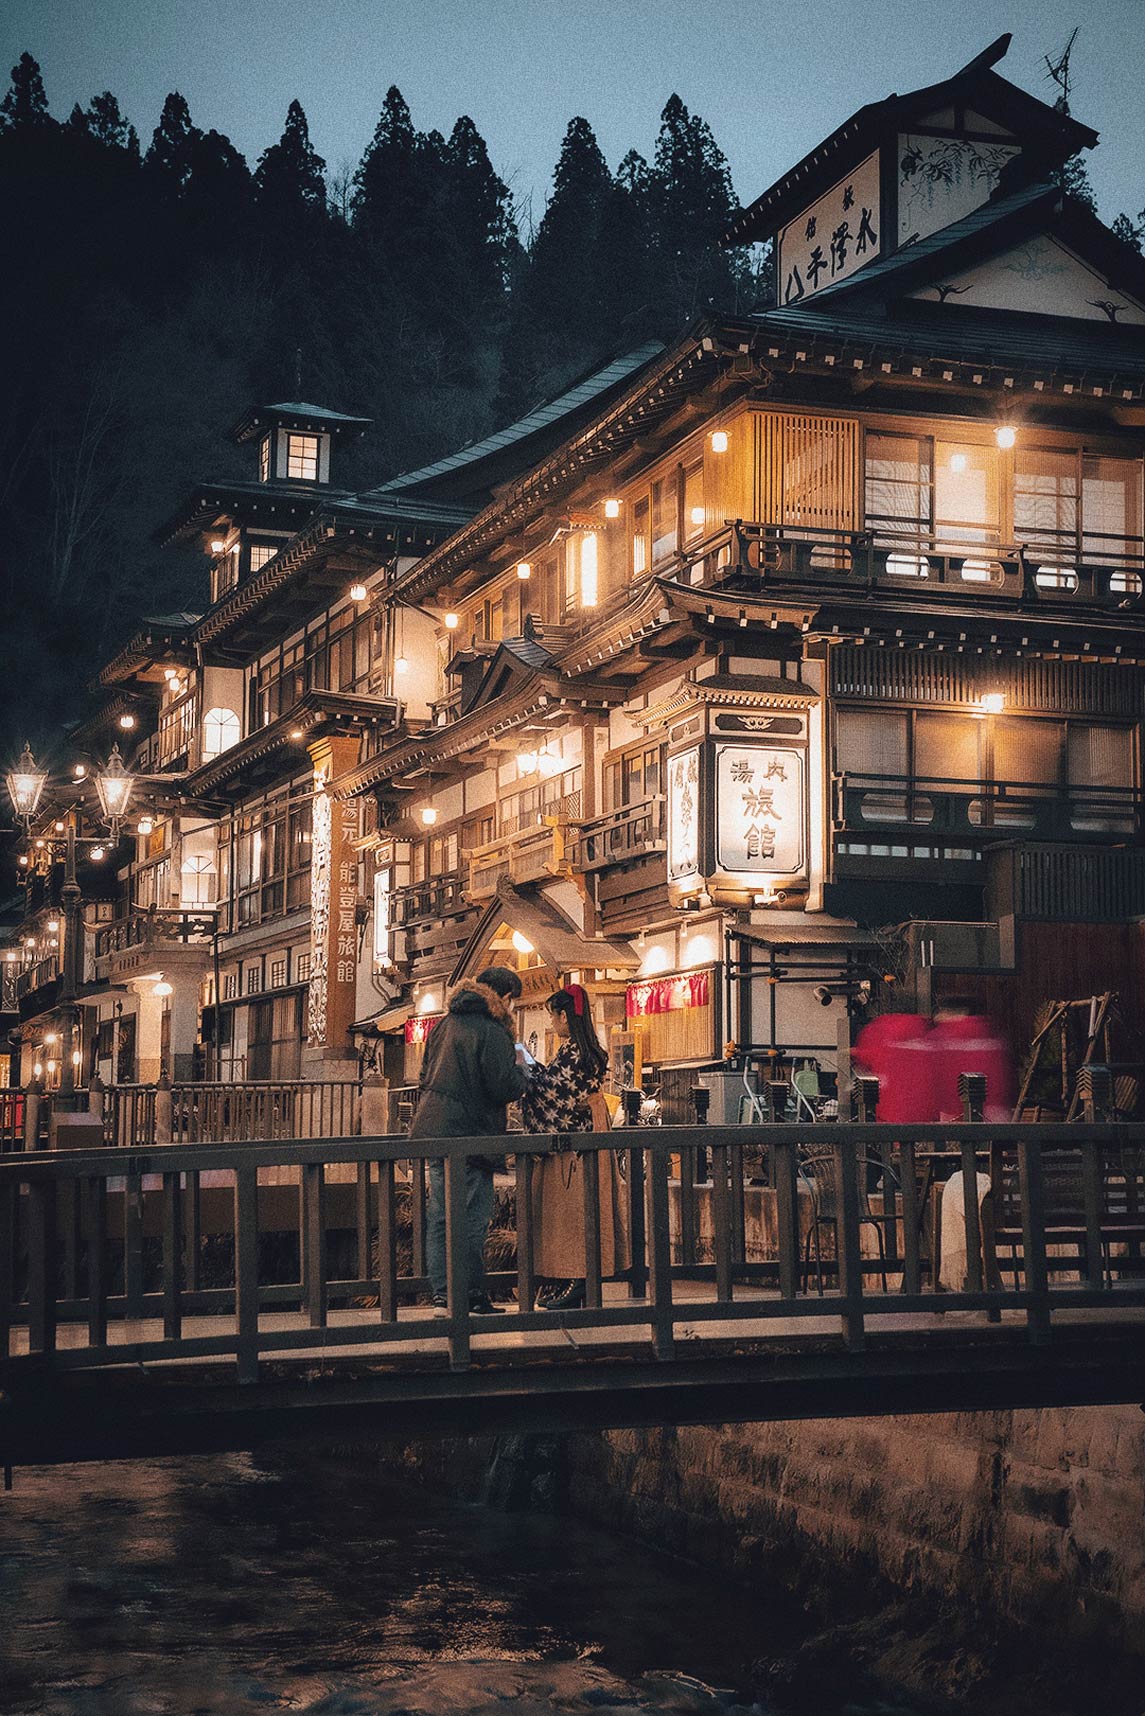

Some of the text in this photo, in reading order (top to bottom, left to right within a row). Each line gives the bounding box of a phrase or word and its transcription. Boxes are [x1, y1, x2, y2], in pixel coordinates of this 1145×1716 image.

[741, 786, 783, 861] 旅館
[337, 798, 358, 982] 湯元 能登屋旅館
